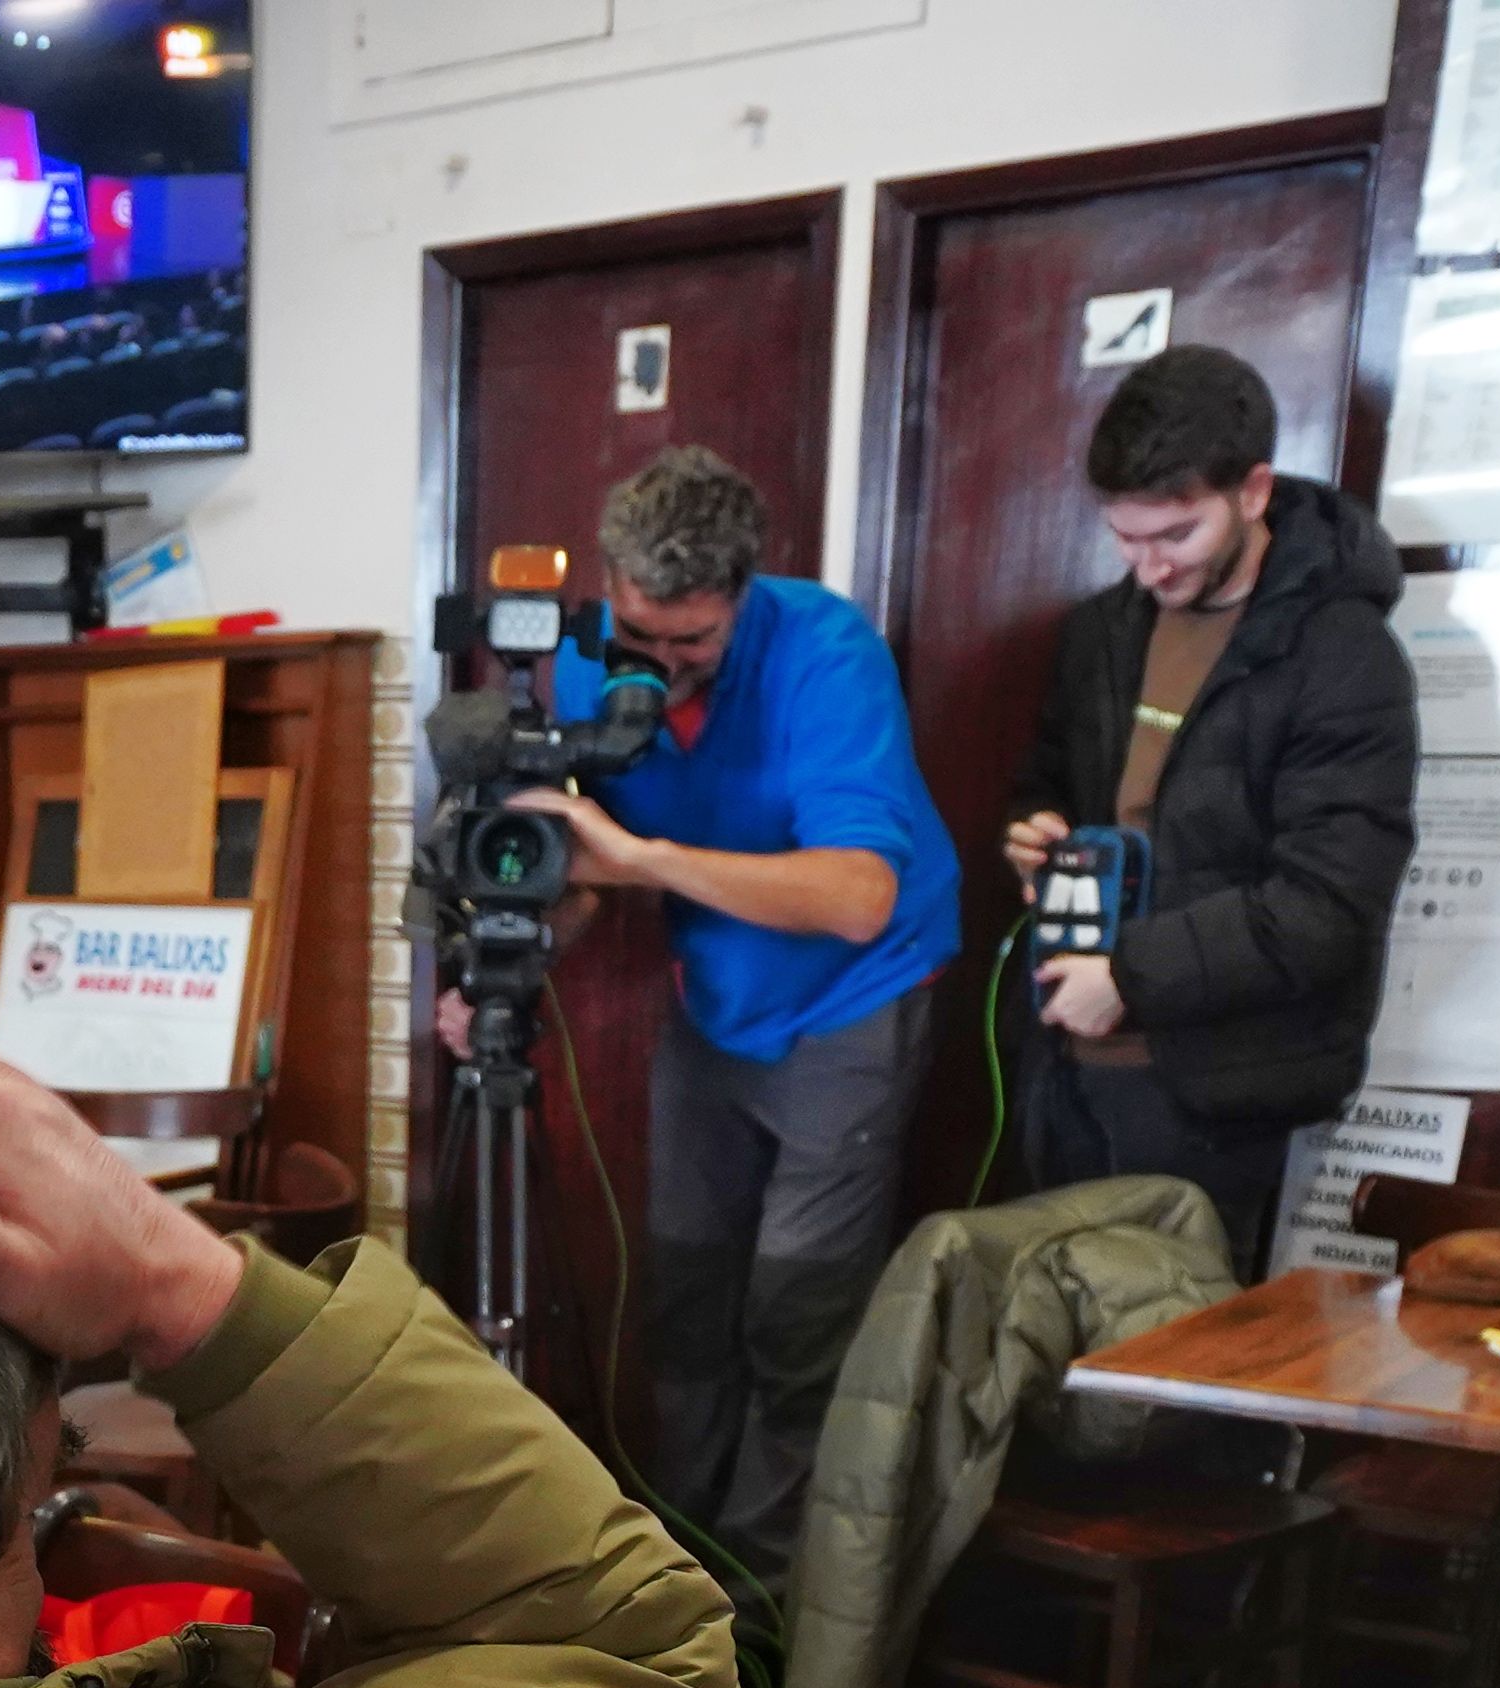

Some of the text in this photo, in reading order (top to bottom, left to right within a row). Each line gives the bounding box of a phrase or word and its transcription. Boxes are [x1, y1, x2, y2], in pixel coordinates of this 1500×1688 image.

[77, 930, 229, 975] BAR BALIXAS
[139, 975, 174, 997] DEL
[1355, 1105, 1442, 1133] BALIXAS
[1304, 1134, 1444, 1163] COMUNICAMOS
